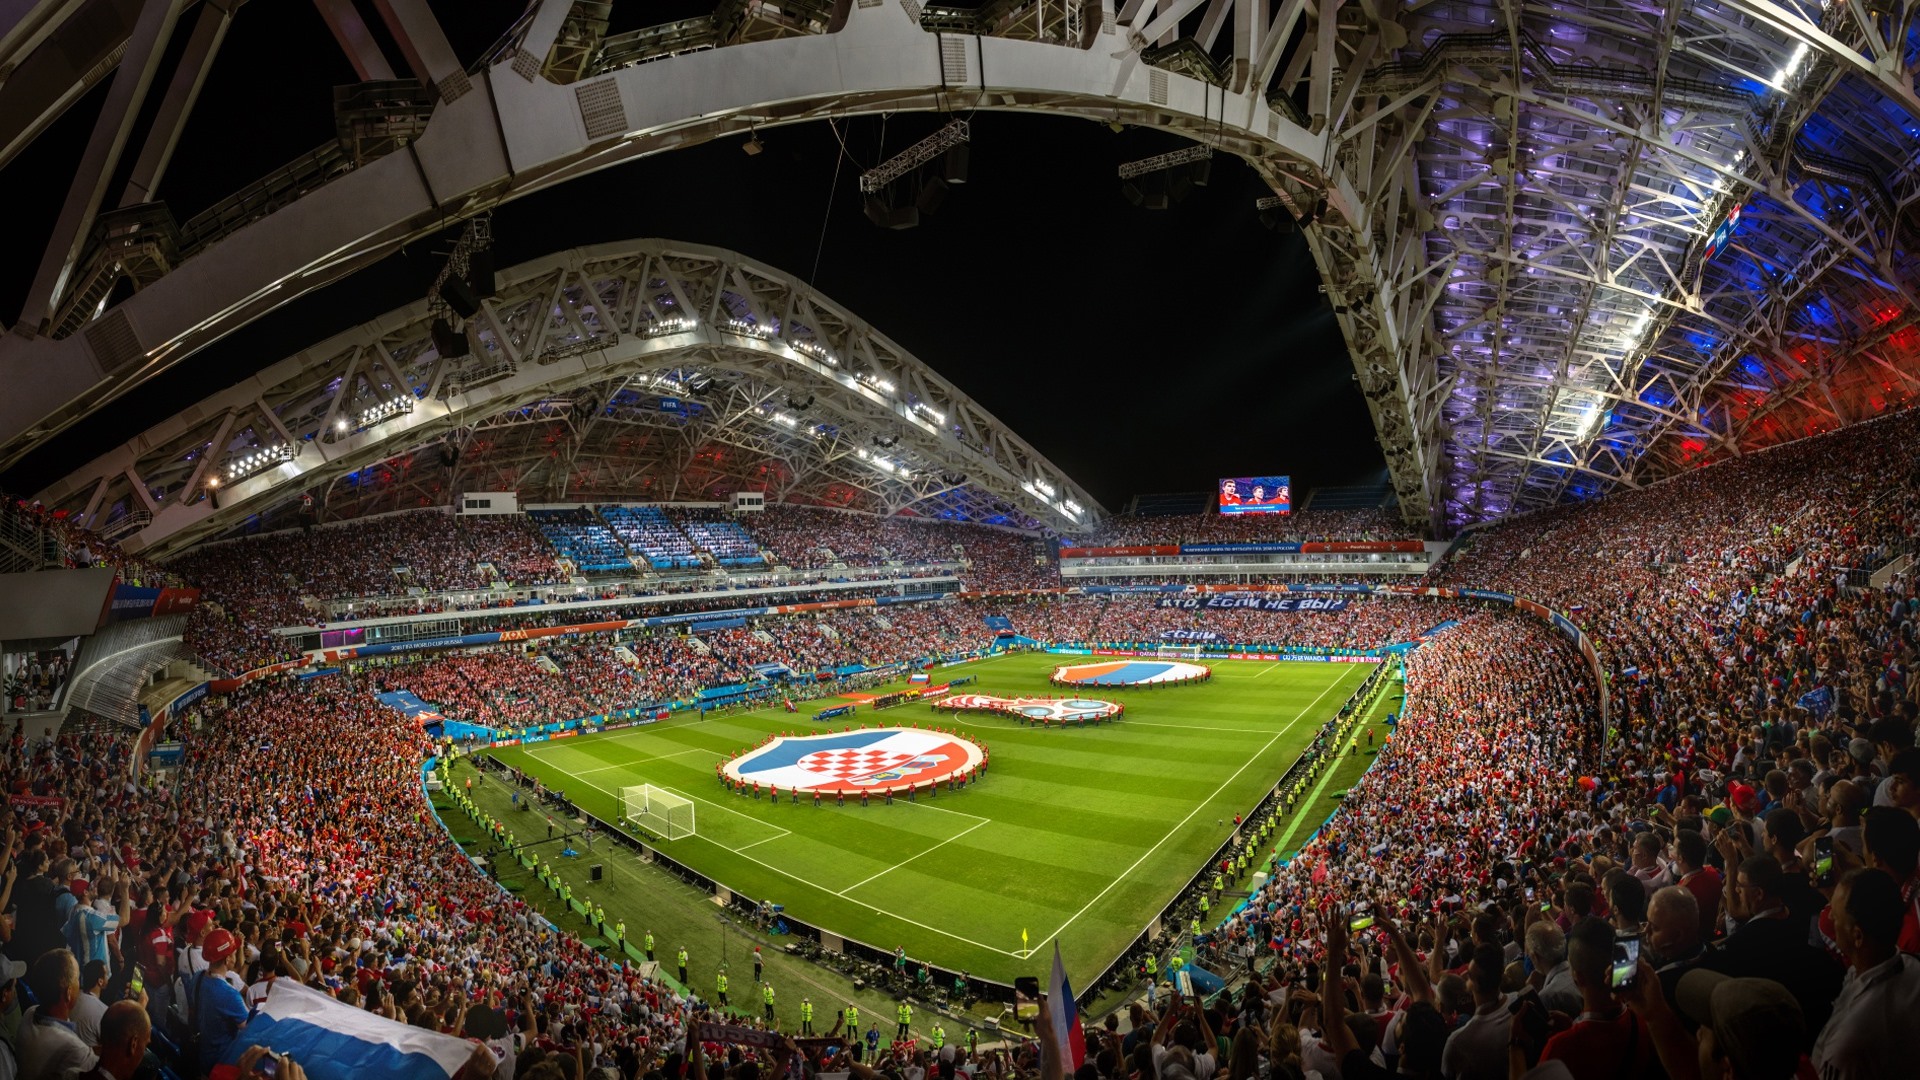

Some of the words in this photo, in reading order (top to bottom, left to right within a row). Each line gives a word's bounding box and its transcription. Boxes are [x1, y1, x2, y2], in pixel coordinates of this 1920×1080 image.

[662, 401, 677, 409] FIFA
[1162, 598, 1200, 609] КТО,
[1207, 597, 1260, 608] ЕСЛИ
[1264, 599, 1289, 609] НЕ
[1298, 599, 1343, 609] ВЫ?
